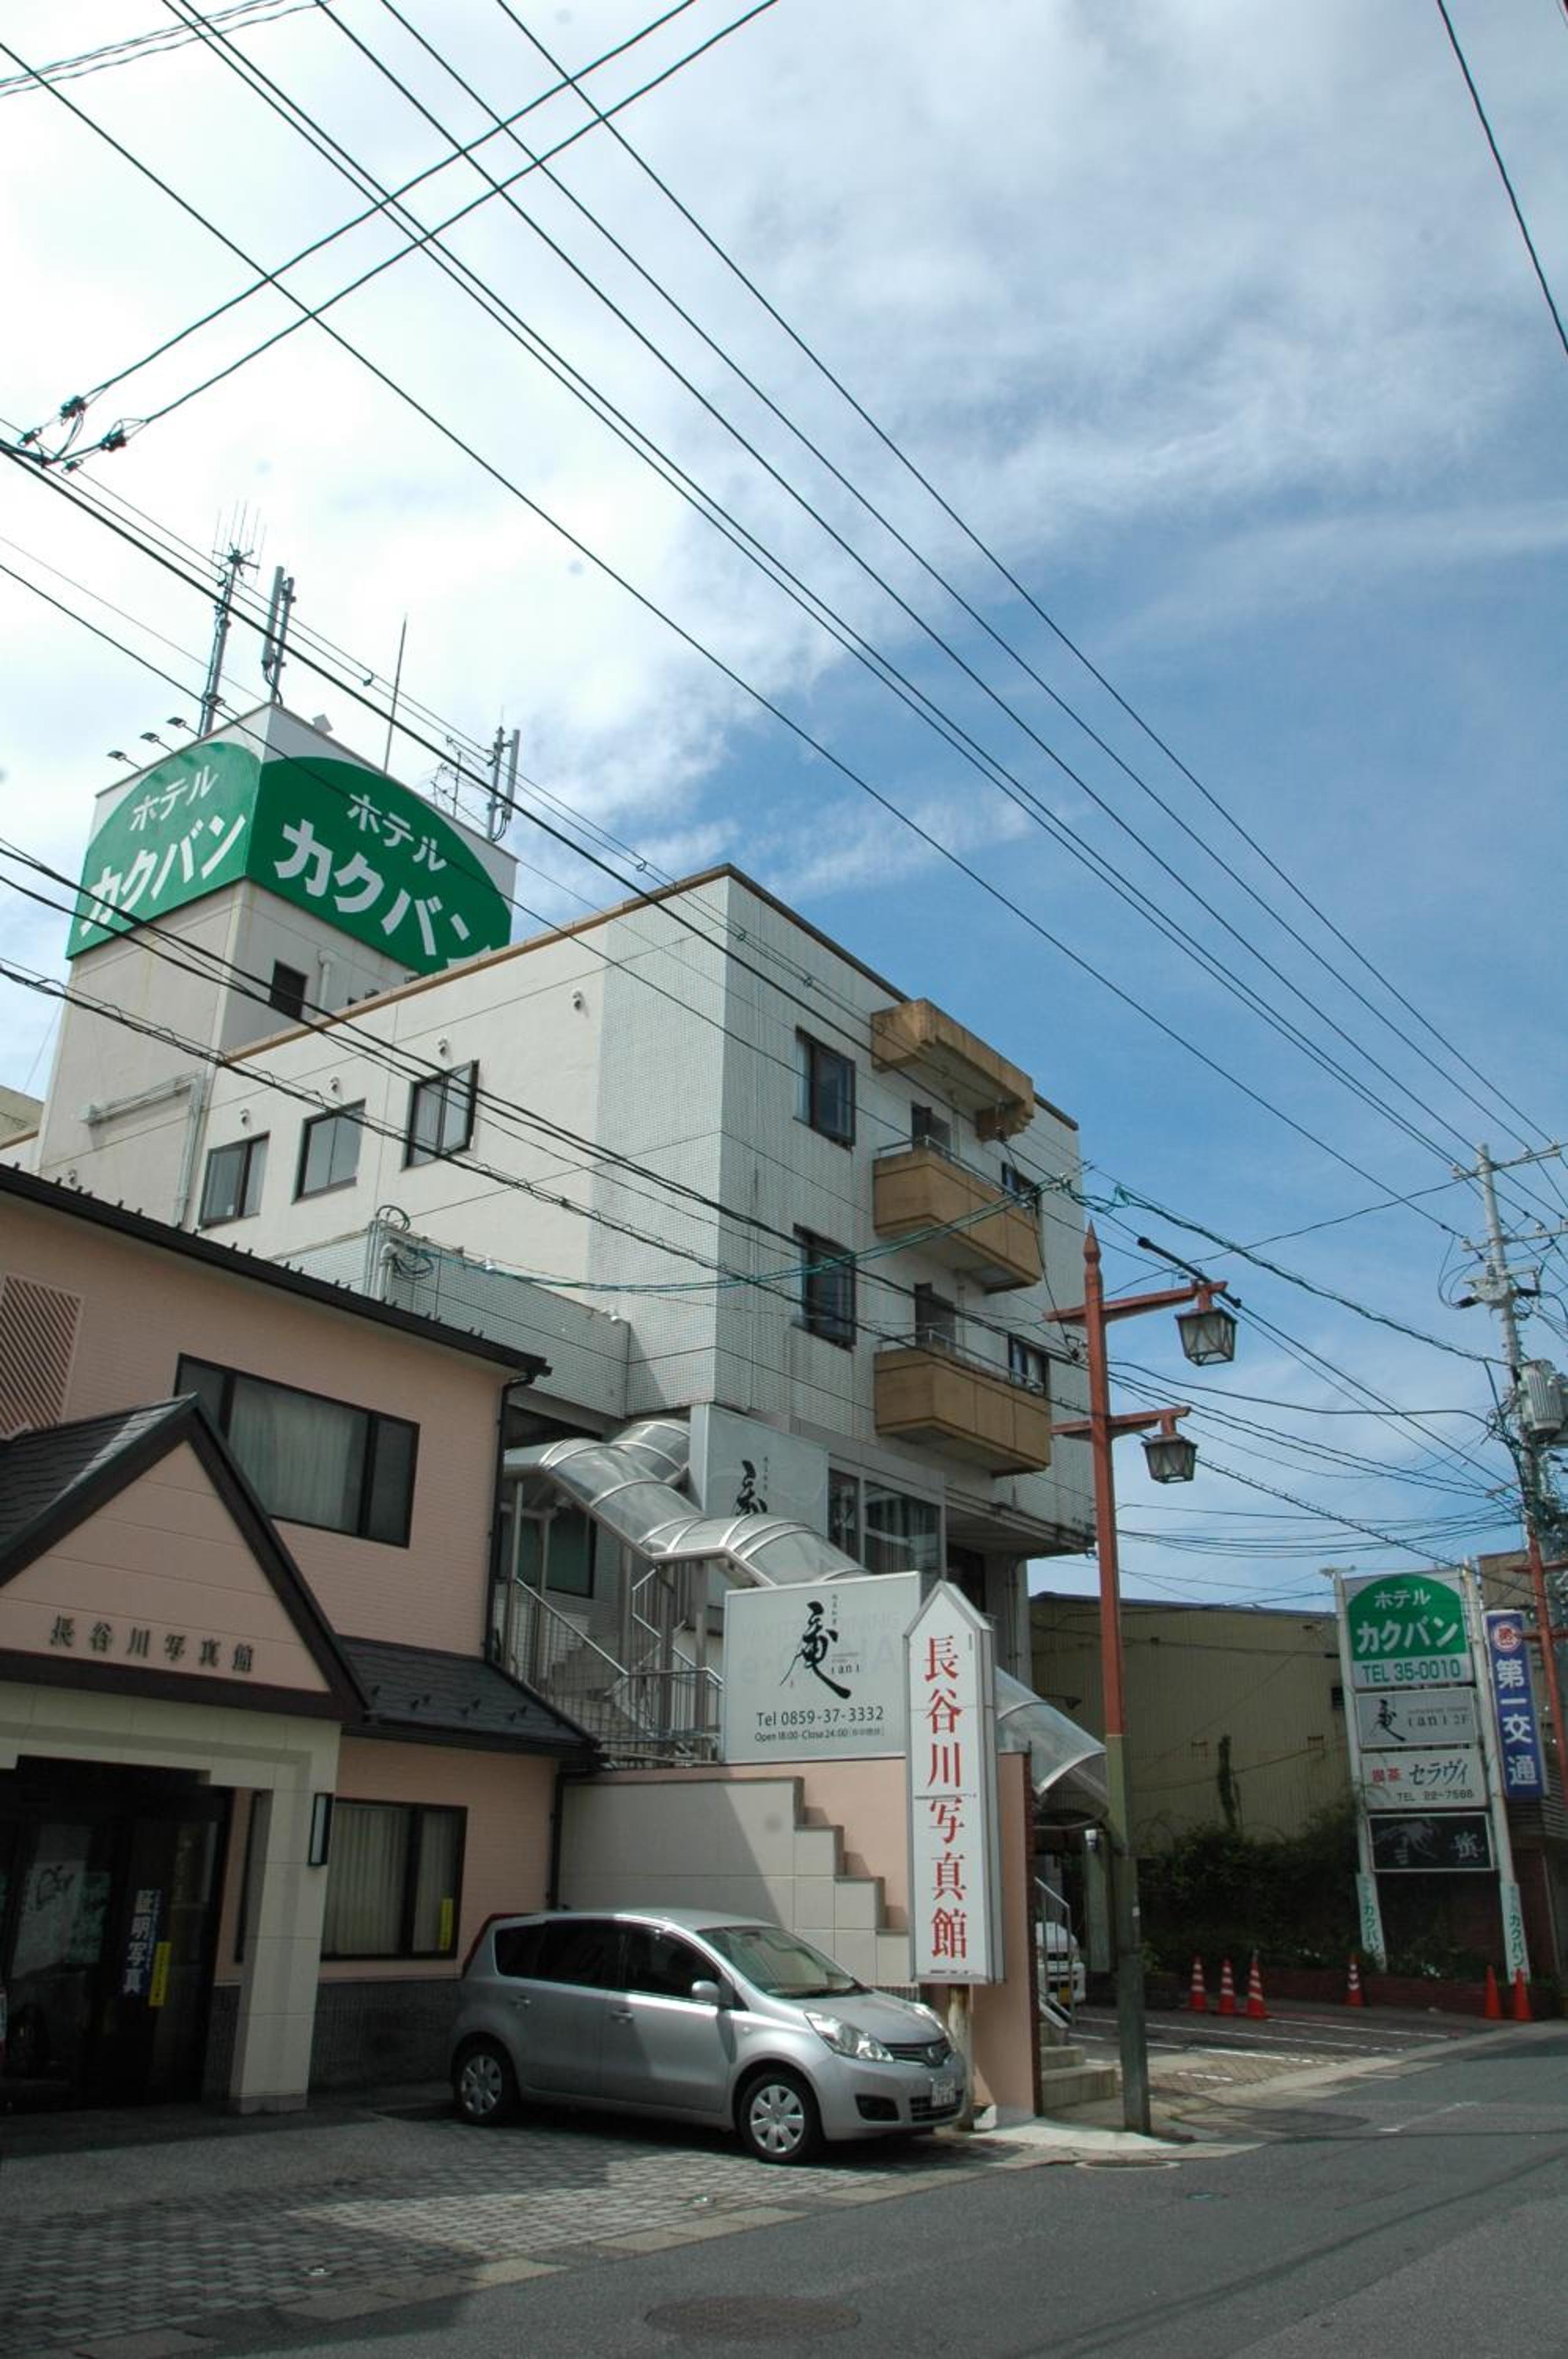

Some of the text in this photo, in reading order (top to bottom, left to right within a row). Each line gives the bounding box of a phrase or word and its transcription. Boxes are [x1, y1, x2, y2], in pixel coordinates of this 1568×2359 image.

[131, 765, 219, 831] ホテル
[347, 793, 447, 872] ホテル
[80, 813, 246, 937] カクバン
[1375, 1588, 1431, 1609] ホテル
[50, 1615, 255, 1674] 長谷川写真館
[1356, 1615, 1459, 1654] カクバン
[1362, 1659, 1460, 1683] TEL 35-0010
[754, 1732, 776, 1742] Open
[756, 1706, 884, 1727] Tel 0859-37-3332
[1496, 1658, 1537, 1786] 第一交通
[1408, 1757, 1468, 1785] セラヴィ
[924, 1635, 968, 1960] 長谷川写真館
[1396, 1792, 1415, 1801] TEL
[123, 1890, 153, 1994] 証明写真
